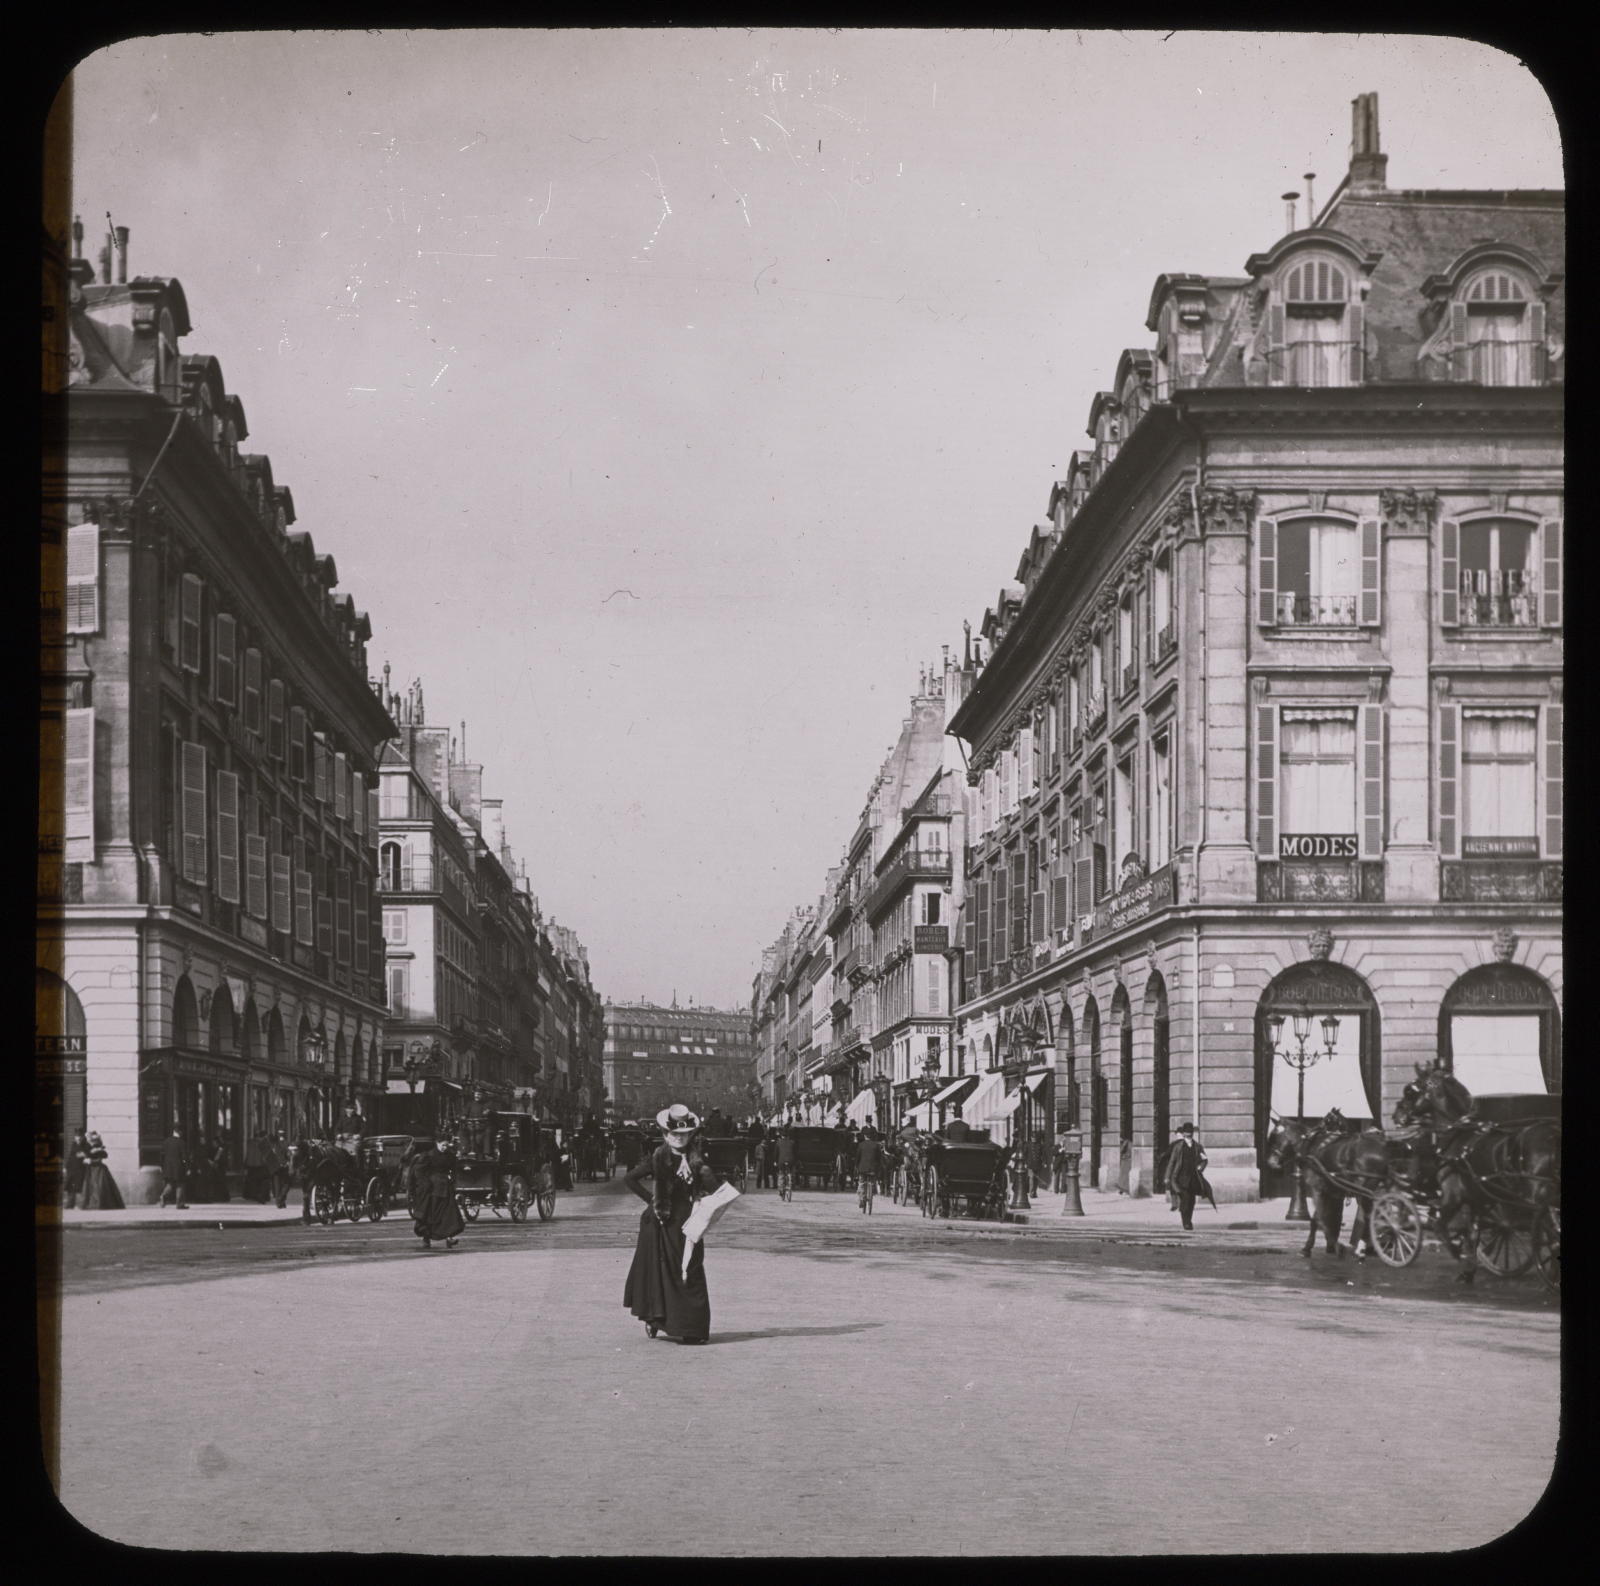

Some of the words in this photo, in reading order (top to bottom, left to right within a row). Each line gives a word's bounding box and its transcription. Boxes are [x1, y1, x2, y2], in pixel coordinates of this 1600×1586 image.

[1463, 568, 1533, 597] ROBES
[1281, 837, 1357, 857] MODES
[1465, 841, 1504, 853] ANCIENNE
[917, 927, 946, 935] ROBES
[1278, 983, 1357, 1000] BOUCHERON
[916, 1025, 949, 1034] MODES
